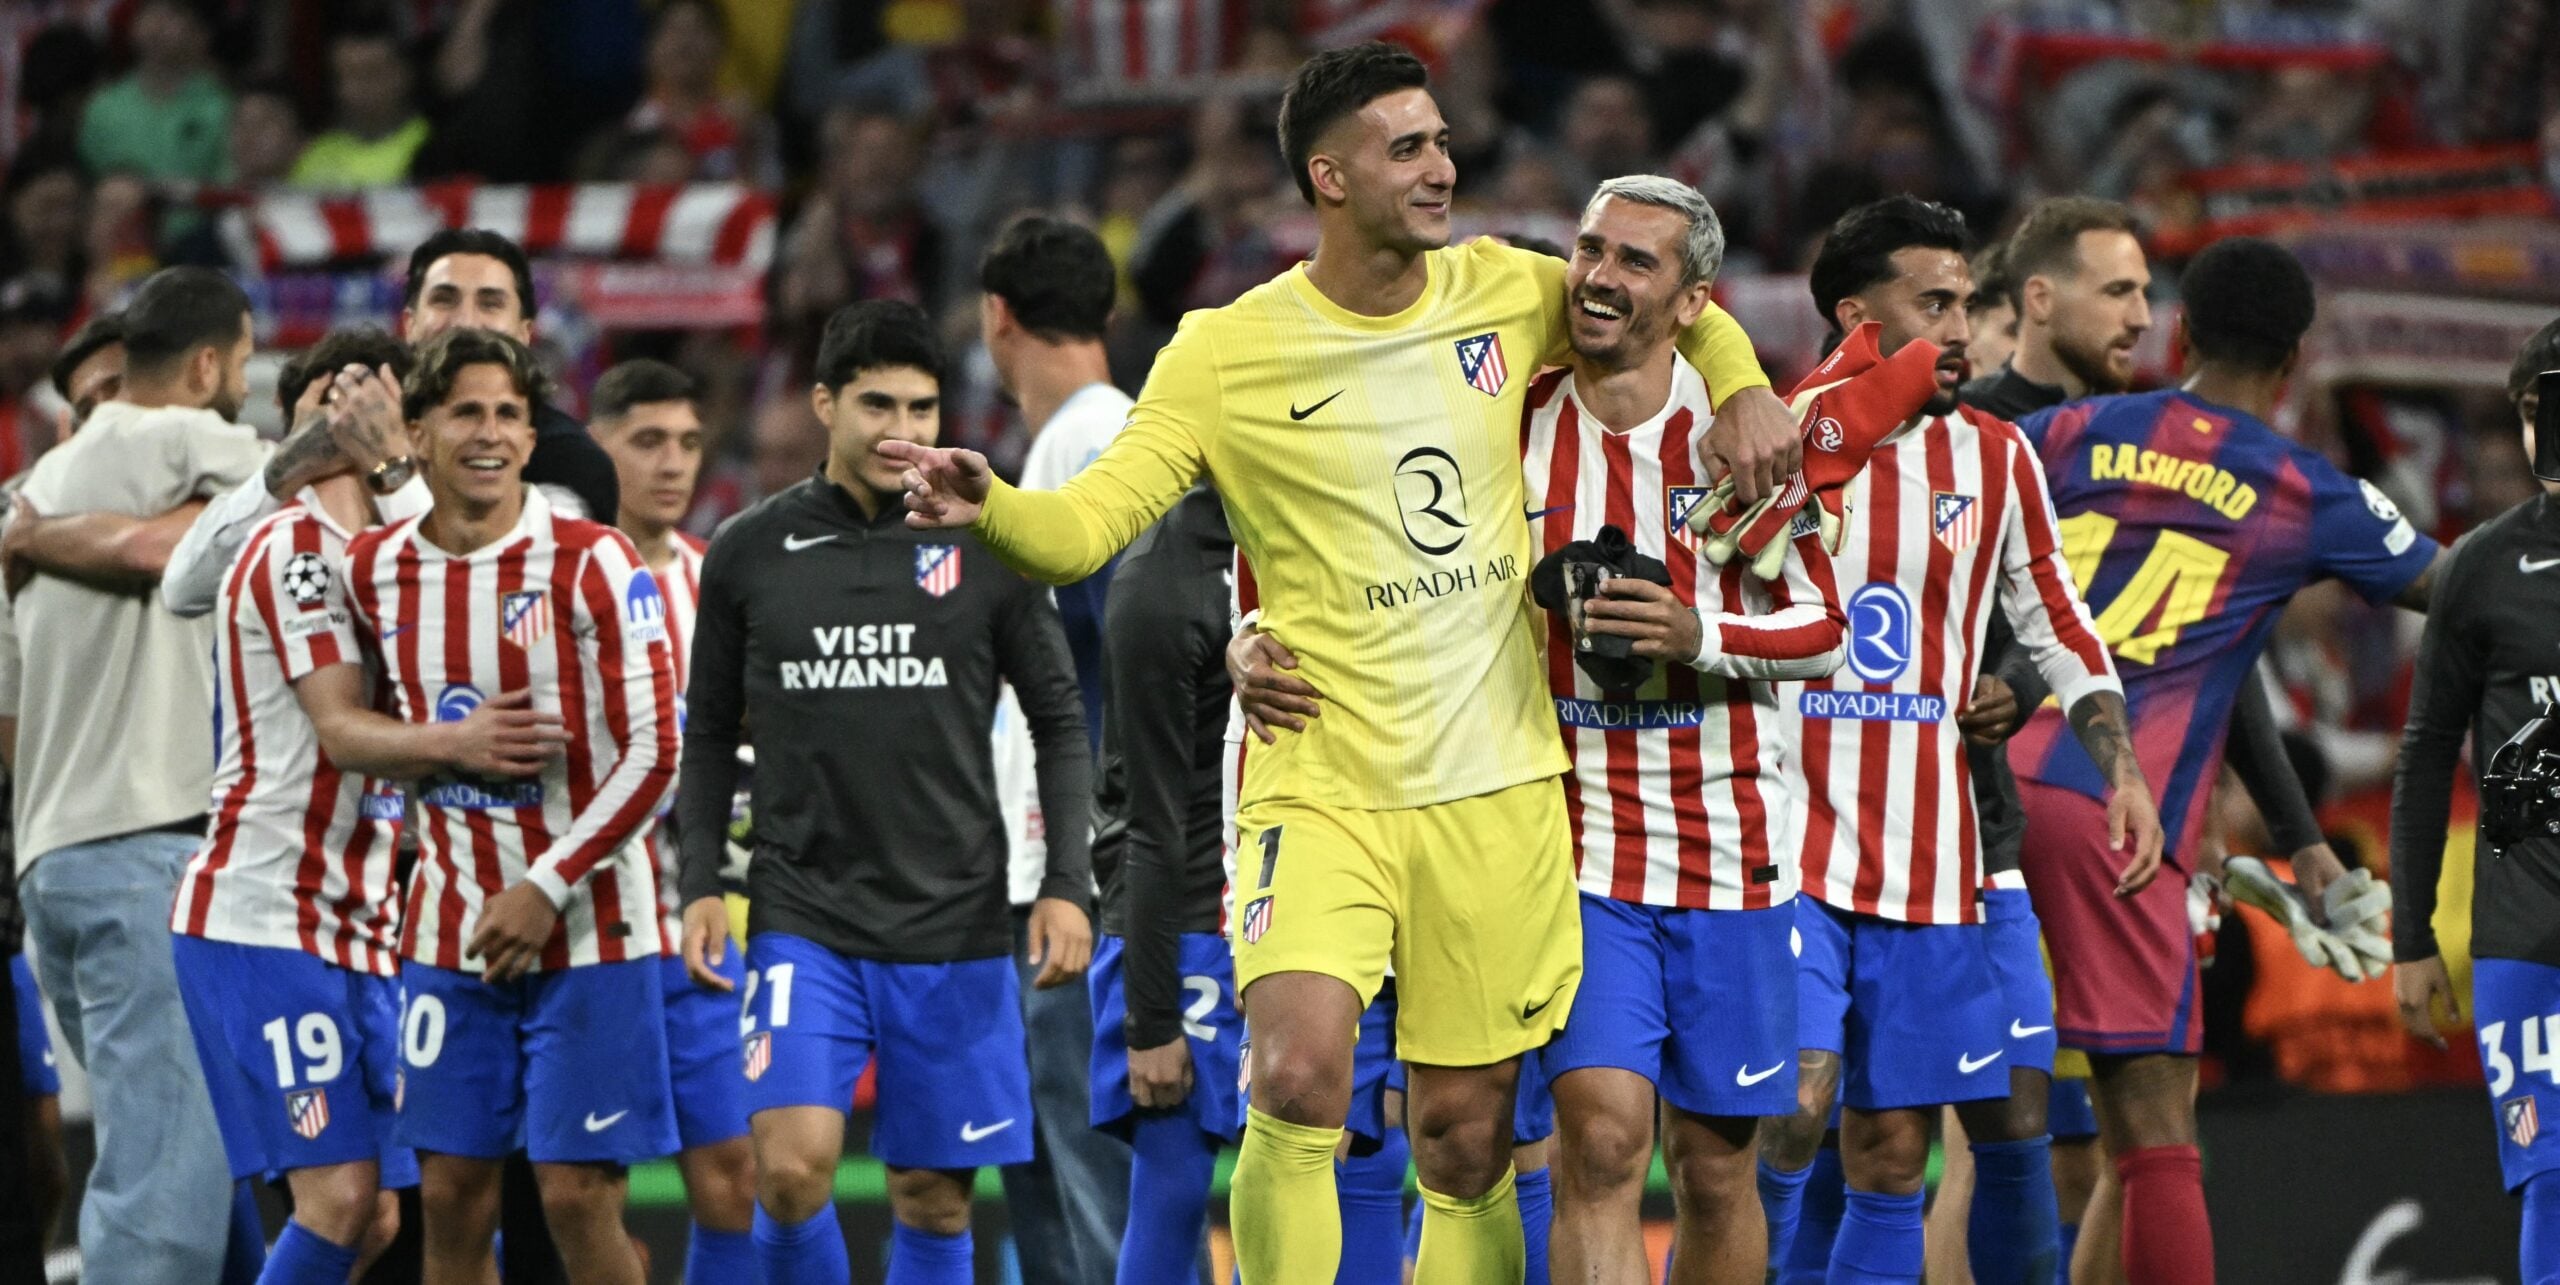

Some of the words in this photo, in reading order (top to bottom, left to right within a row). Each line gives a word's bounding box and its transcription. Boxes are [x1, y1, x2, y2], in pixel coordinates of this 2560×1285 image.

[2091, 443, 2258, 521] RASHFORD
[1365, 564, 1477, 611] RIYADH
[1484, 554, 1518, 585] AIR
[812, 623, 916, 656] VISIT
[780, 656, 948, 690] RWANDA
[1555, 700, 1644, 726] RIYADH
[1652, 702, 1698, 725] AIR
[1805, 692, 1899, 717] RIYADH
[1905, 697, 1941, 721] AIR
[1258, 824, 1283, 890] 1
[740, 962, 794, 1038] 21
[263, 1012, 343, 1089] 19
[2480, 1013, 2560, 1098] 34
